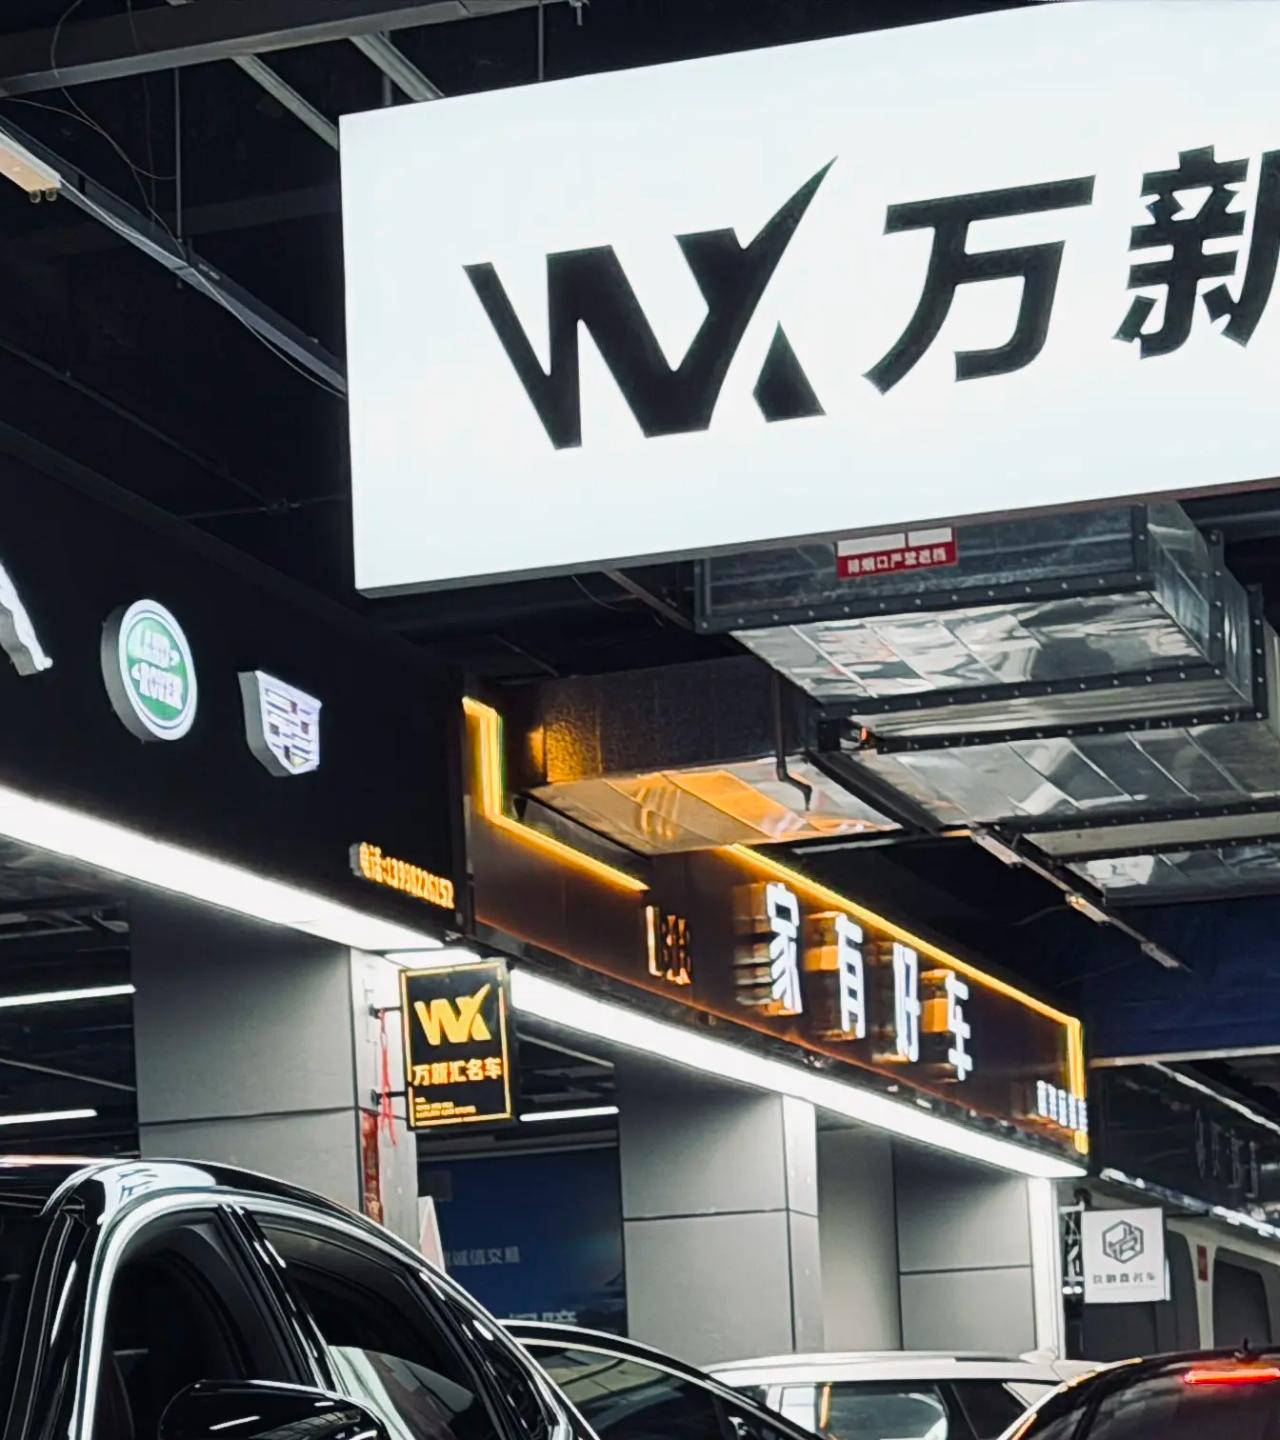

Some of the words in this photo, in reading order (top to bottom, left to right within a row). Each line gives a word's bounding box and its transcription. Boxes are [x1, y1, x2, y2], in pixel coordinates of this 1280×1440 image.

[861, 145, 1280, 396] 万新
[412, 1056, 503, 1086] 万新汇名车
[766, 881, 973, 1082] 家有好车
